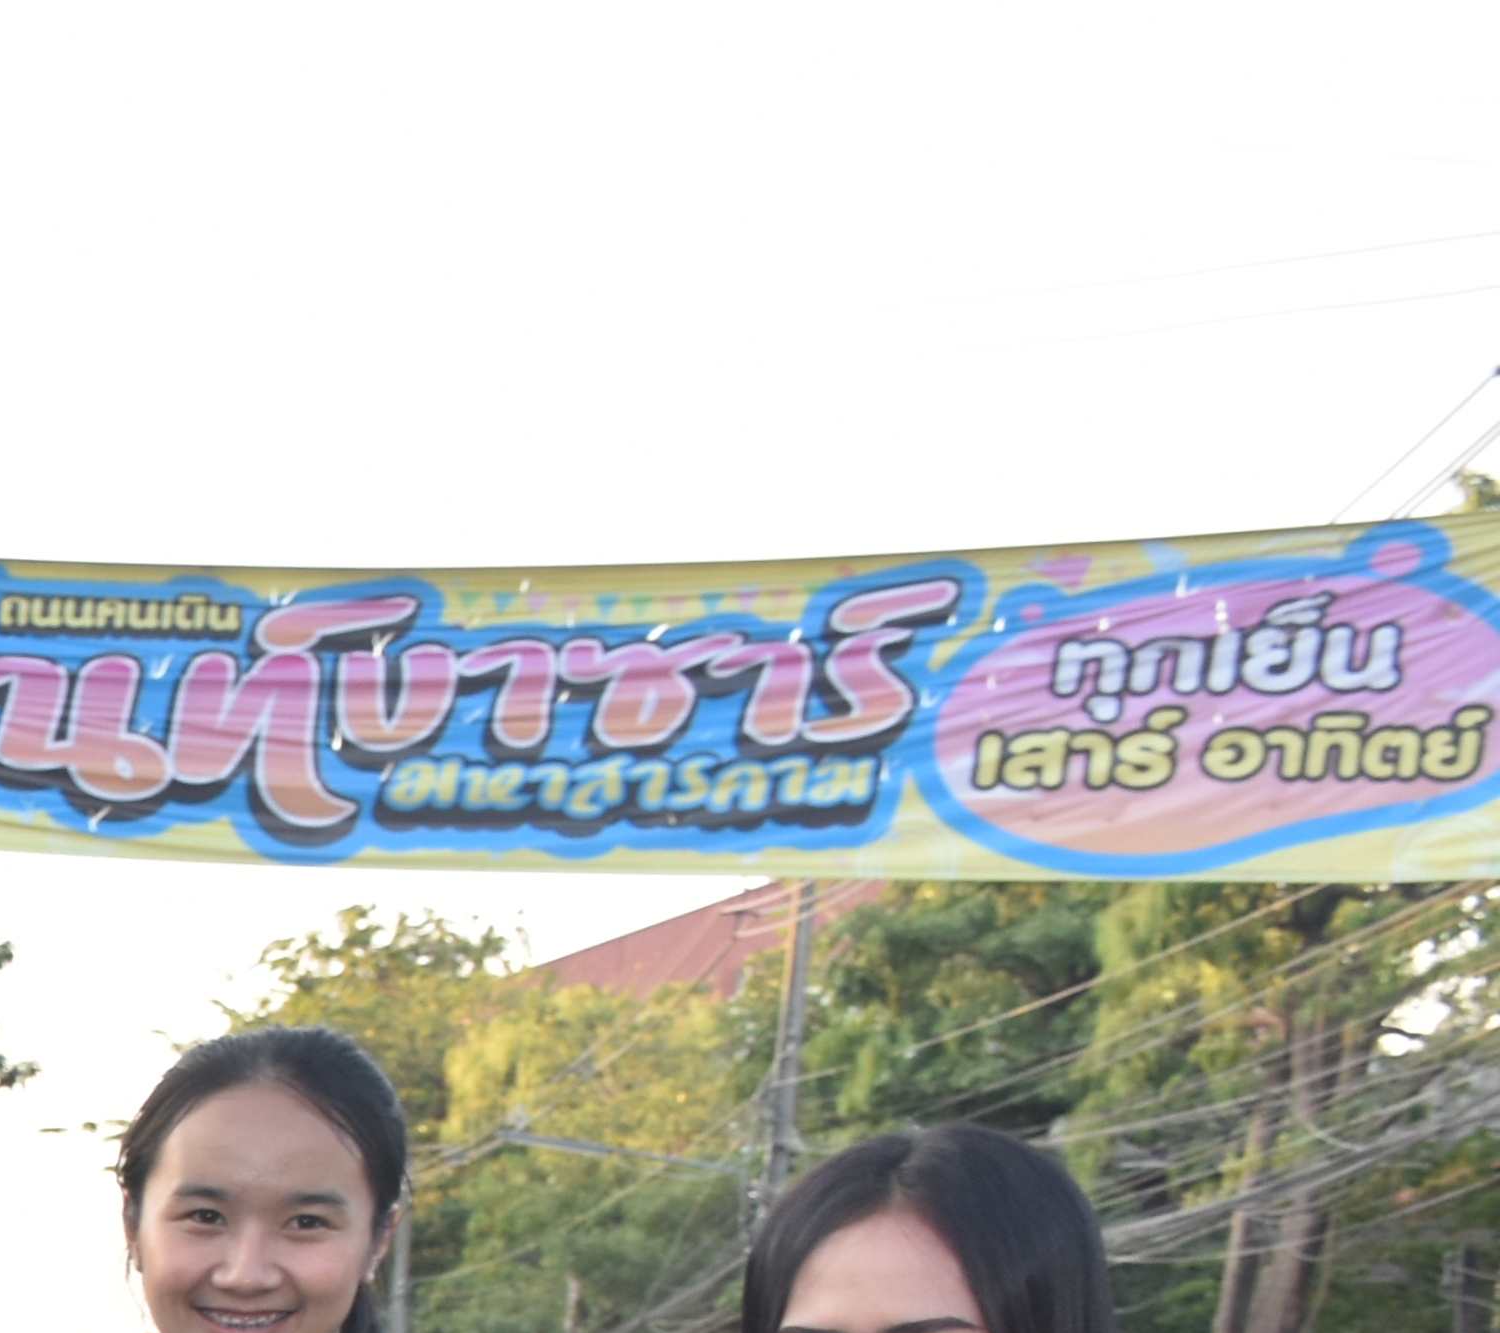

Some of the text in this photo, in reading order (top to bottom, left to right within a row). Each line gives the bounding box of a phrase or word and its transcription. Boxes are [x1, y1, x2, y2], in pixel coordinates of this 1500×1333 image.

[0, 595, 241, 632] ถนนคนเดิน
[1052, 592, 1404, 723] ทุกเย็น
[973, 704, 1494, 791] เสาร์ อาทิตย์
[384, 754, 881, 819] มหาสารคาม
